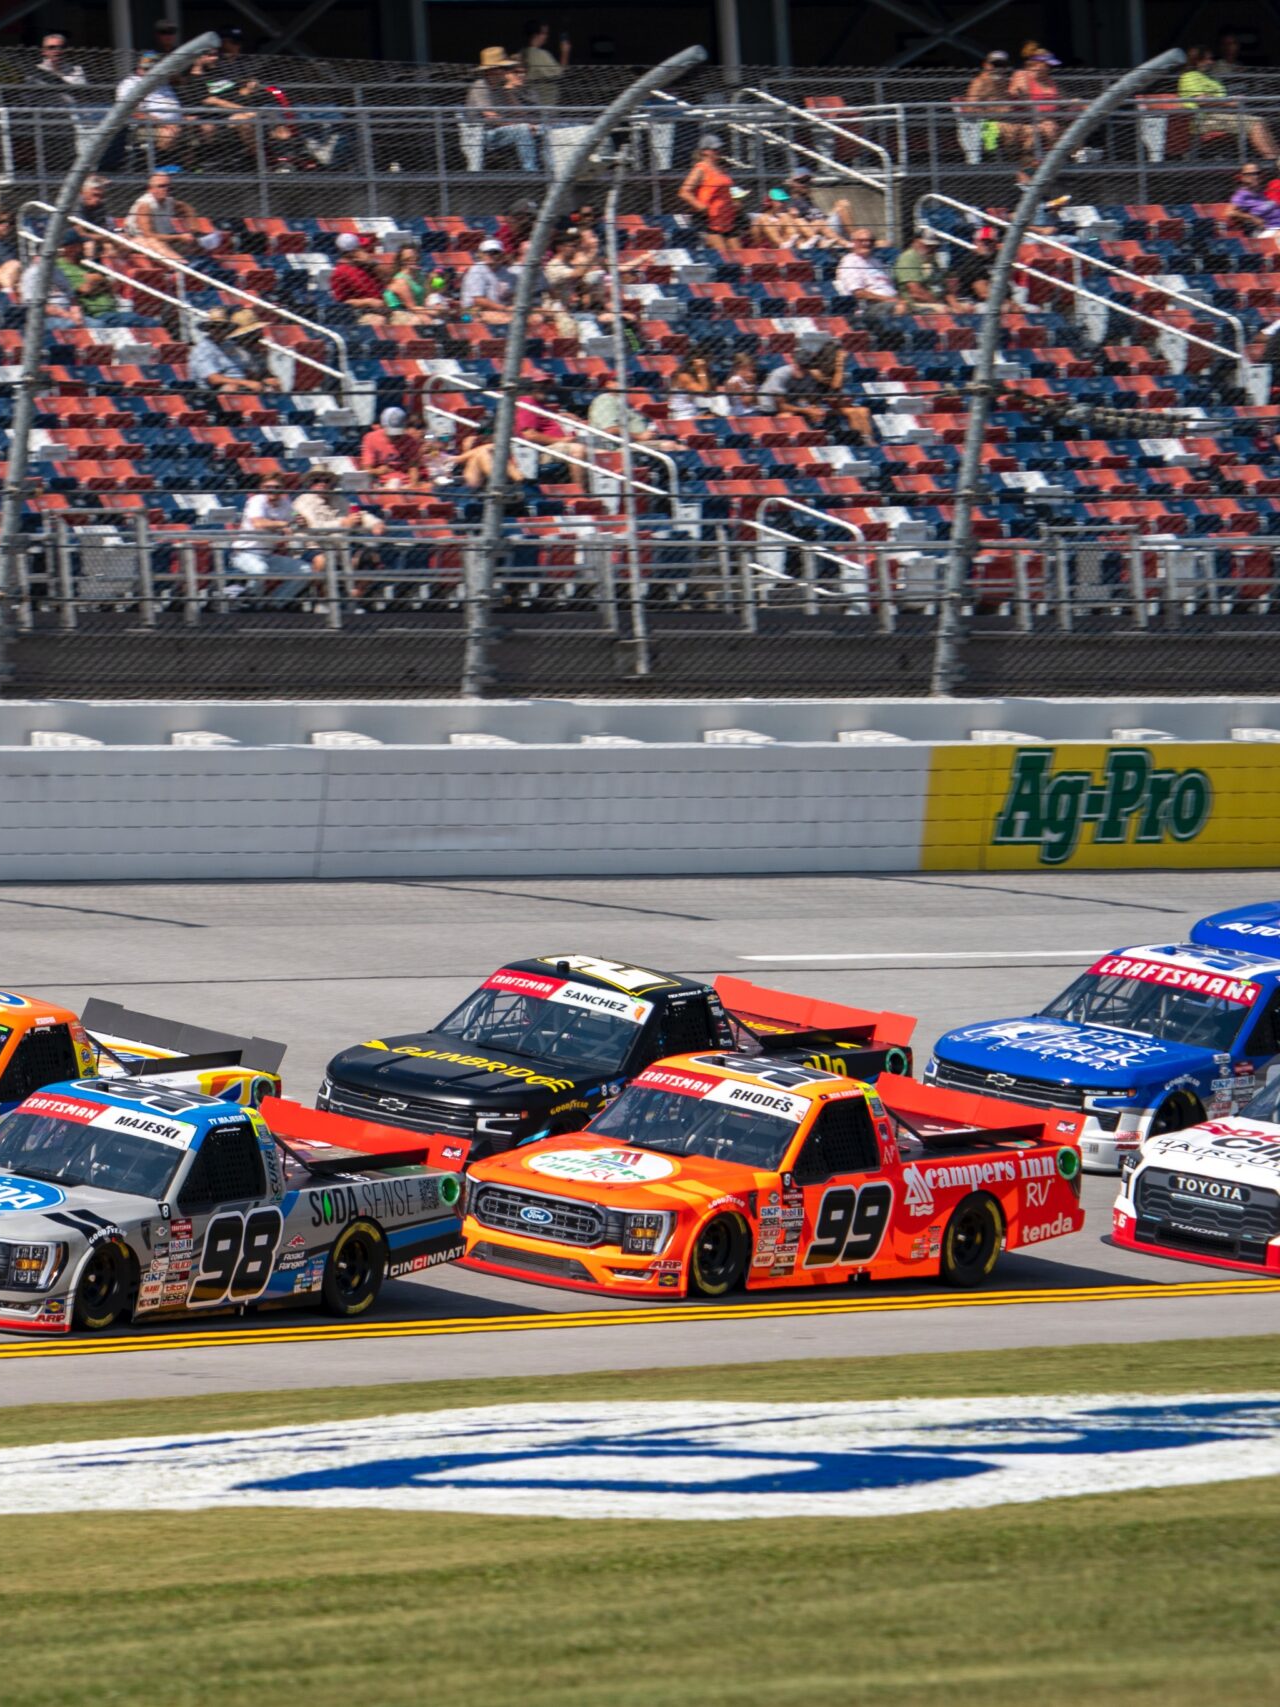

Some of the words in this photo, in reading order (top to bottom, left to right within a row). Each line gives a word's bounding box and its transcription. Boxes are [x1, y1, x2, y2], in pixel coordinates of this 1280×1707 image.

[992, 746, 1215, 864] Ag-Pro
[490, 973, 553, 993] CRAFTSMAN
[1100, 959, 1247, 1000] CRAFTSMAN
[562, 989, 629, 1013] SANCHEZ
[391, 1045, 576, 1094] GAINBRIDGE
[638, 1071, 713, 1094] CRAFTSMAN
[21, 1096, 99, 1121] CRAFTSMAN
[549, 1099, 590, 1116] GOODYEAR
[729, 1087, 794, 1114] RHODES
[114, 1115, 182, 1140] MAJESKI
[923, 1159, 1017, 1193] campers
[1018, 1150, 1057, 1180] inn
[1025, 1180, 1051, 1209] RV
[1176, 1176, 1243, 1201] TOYOTA
[161, 1204, 169, 1218] 8
[308, 1184, 360, 1229] SODA
[361, 1178, 415, 1220] SENSE
[88, 1225, 129, 1245] GOODYEAR
[803, 1180, 894, 1270] 99
[1022, 1211, 1074, 1244] tenda
[1170, 1221, 1230, 1238] TUNDRA
[186, 1205, 285, 1309] 98
[389, 1243, 466, 1277] CINCINNATI
[650, 1261, 682, 1270] ARP
[144, 1273, 165, 1283] SKF
[36, 1313, 66, 1322] ARP
